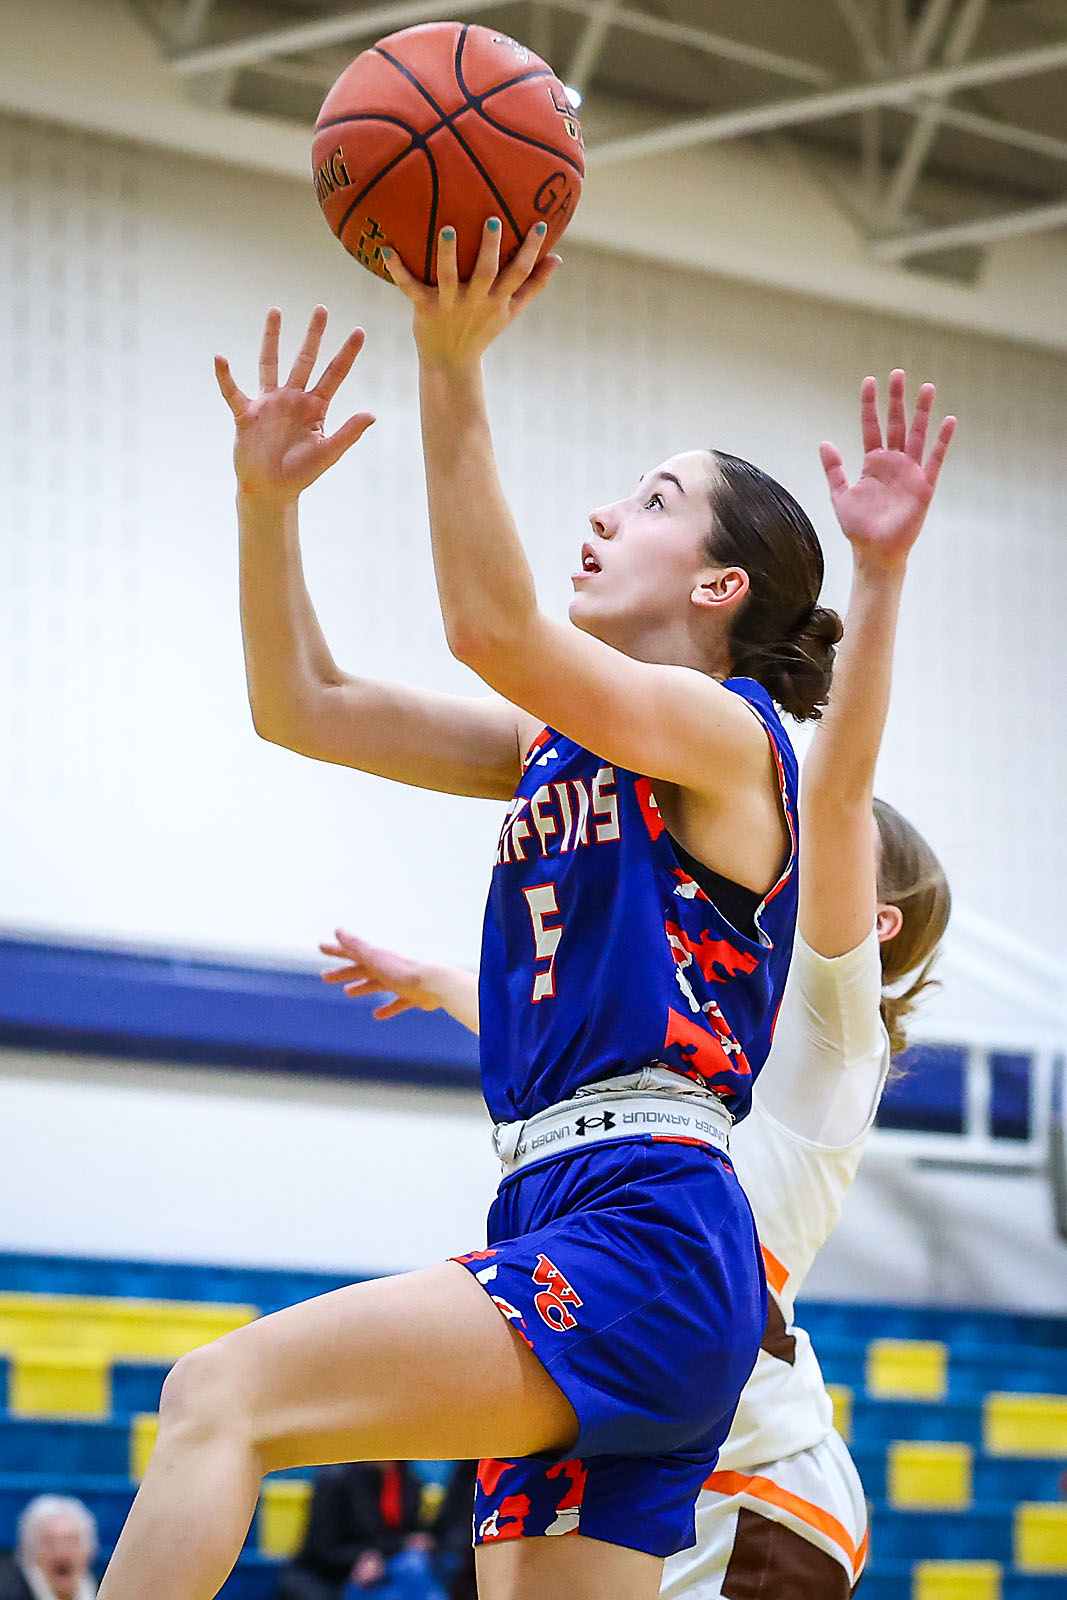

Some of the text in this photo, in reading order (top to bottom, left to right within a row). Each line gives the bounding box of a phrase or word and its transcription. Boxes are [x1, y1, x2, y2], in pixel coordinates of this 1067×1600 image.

[522, 882, 564, 1004] 5
[531, 1125, 571, 1150] UNDER
[622, 1110, 727, 1143] UNDER ARMOUR
[531, 1253, 584, 1332] WC
